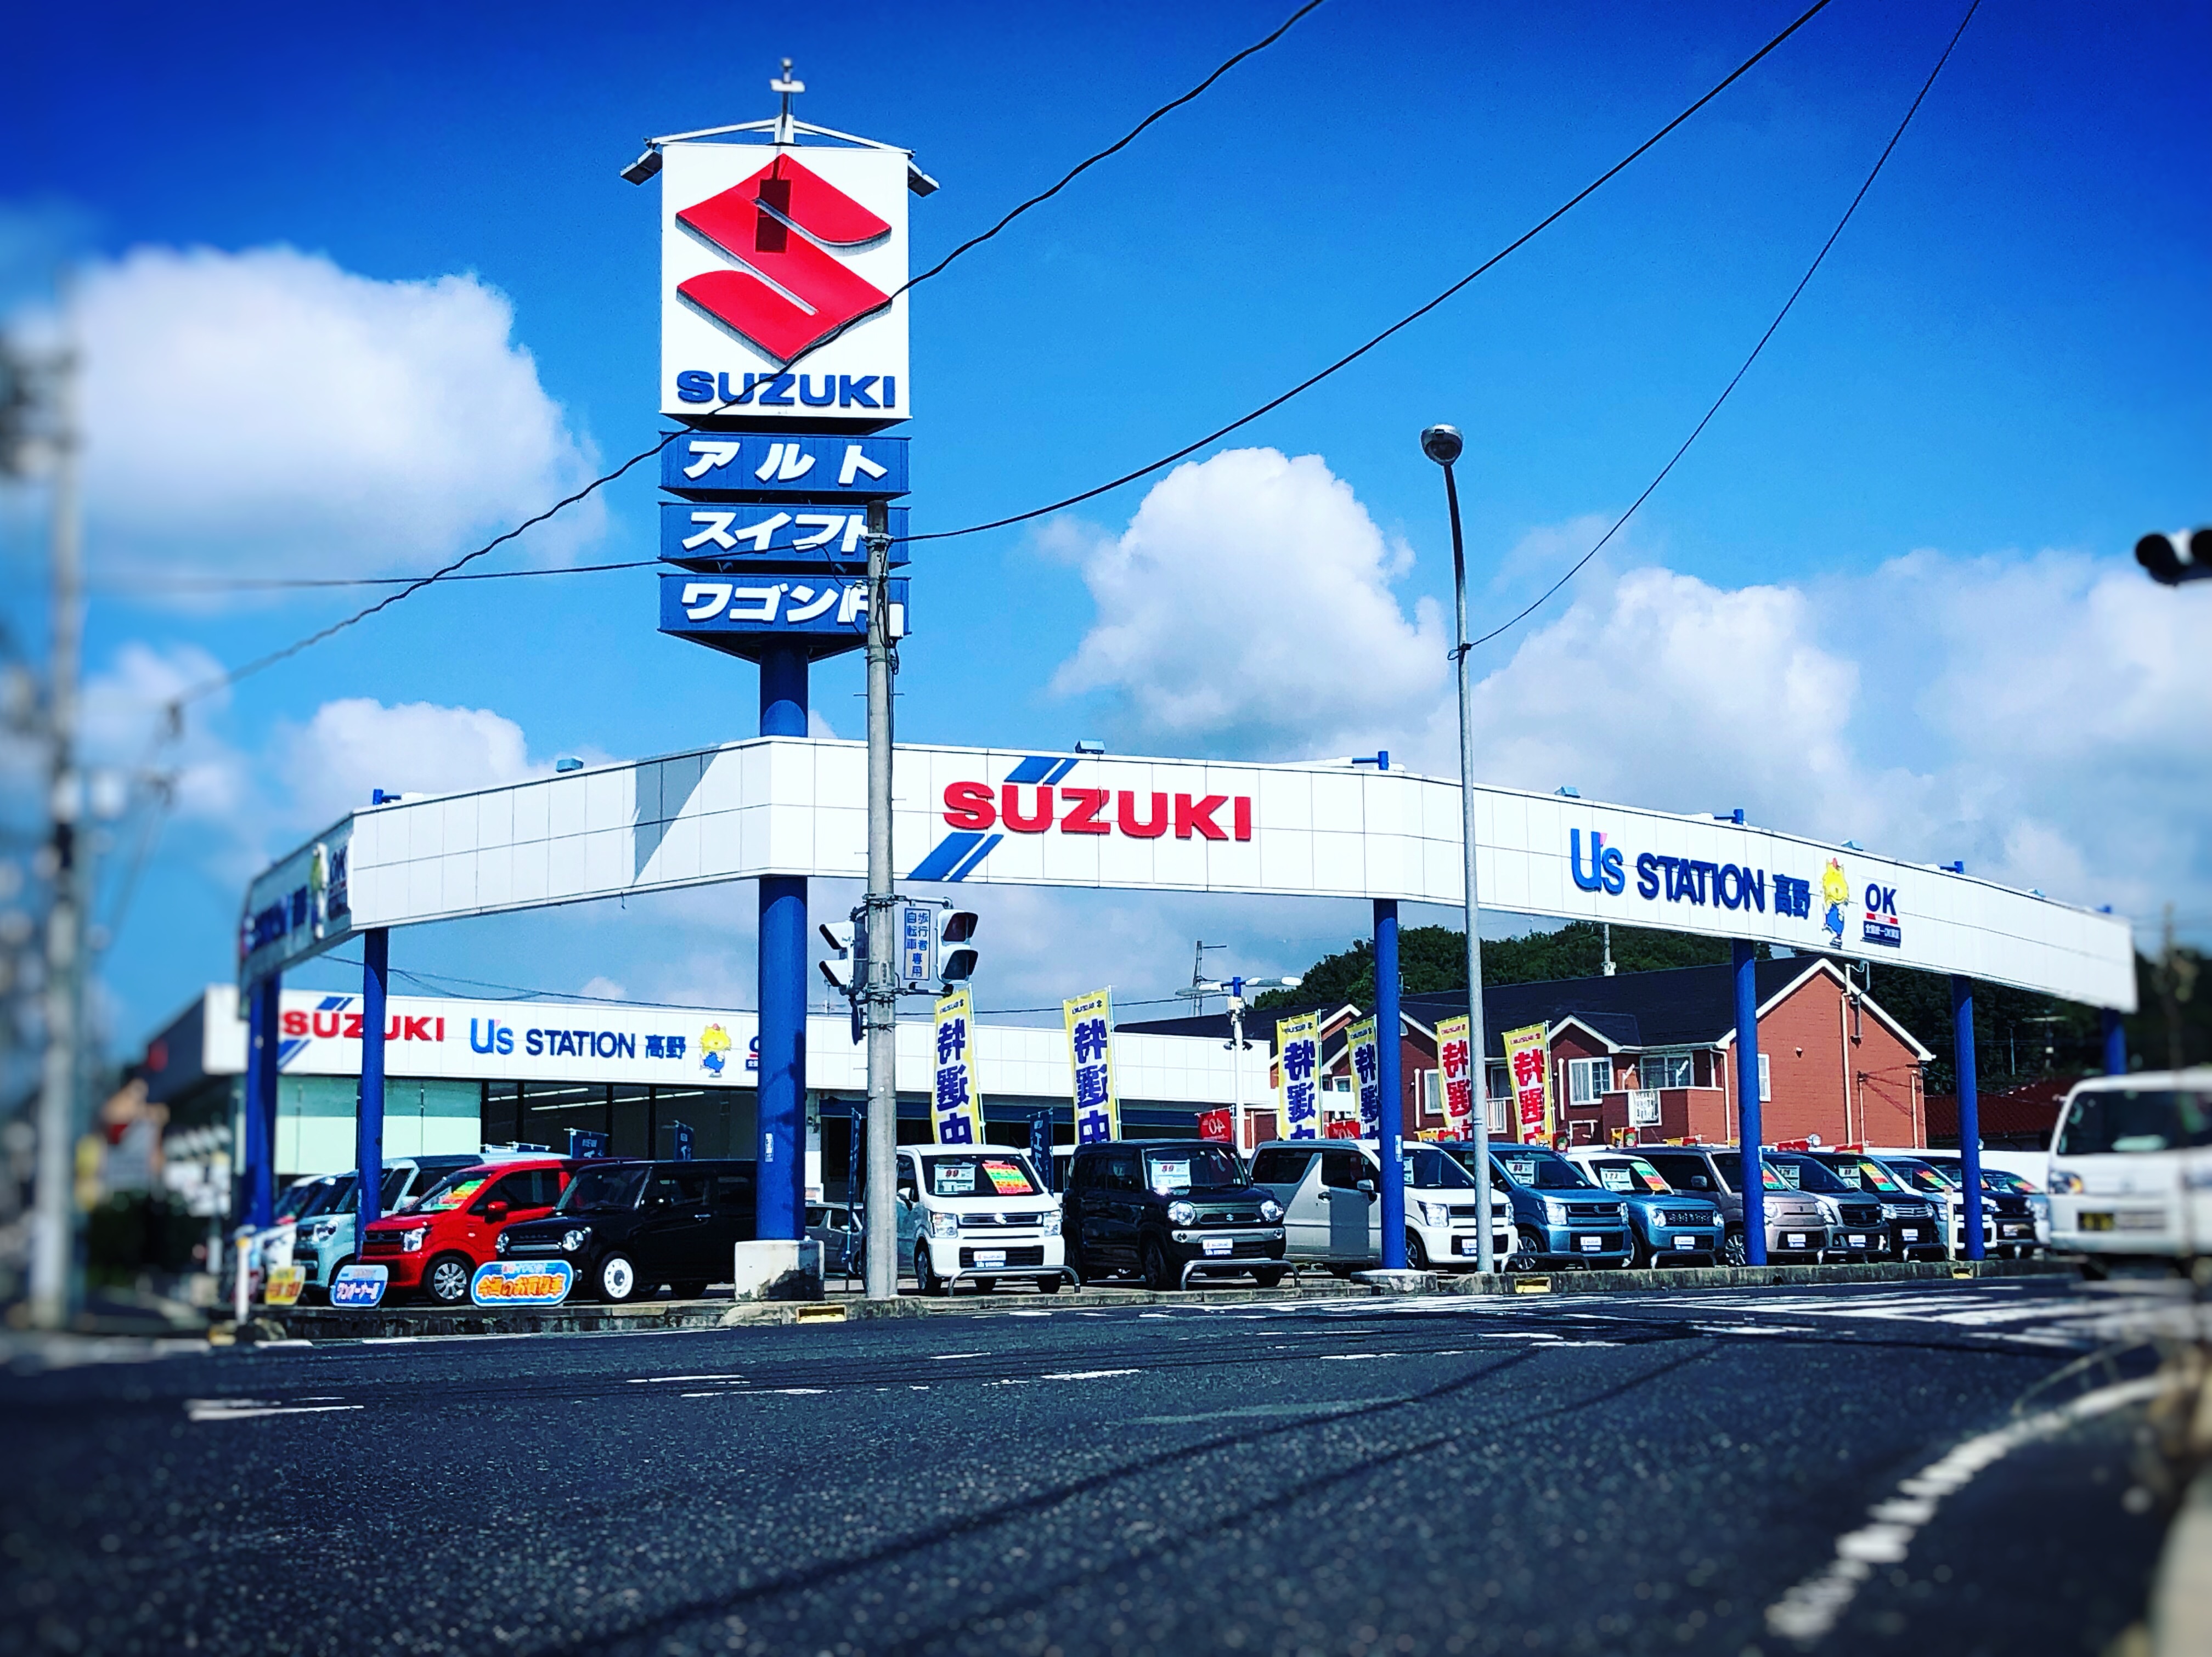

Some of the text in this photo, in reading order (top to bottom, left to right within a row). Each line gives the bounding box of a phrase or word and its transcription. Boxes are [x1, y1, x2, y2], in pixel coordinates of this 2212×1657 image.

[676, 370, 895, 409] SUZUKI
[684, 440, 888, 484] アルト
[943, 781, 1251, 841] SUZUKI
[1637, 852, 1765, 913] STATION
[1773, 874, 1810, 919] 高野
[1865, 884, 1897, 916] OK
[907, 912, 917, 950] 自転車
[918, 912, 928, 951] 歩行者
[526, 1028, 635, 1059] STATION
[645, 1034, 686, 1059] 高野
